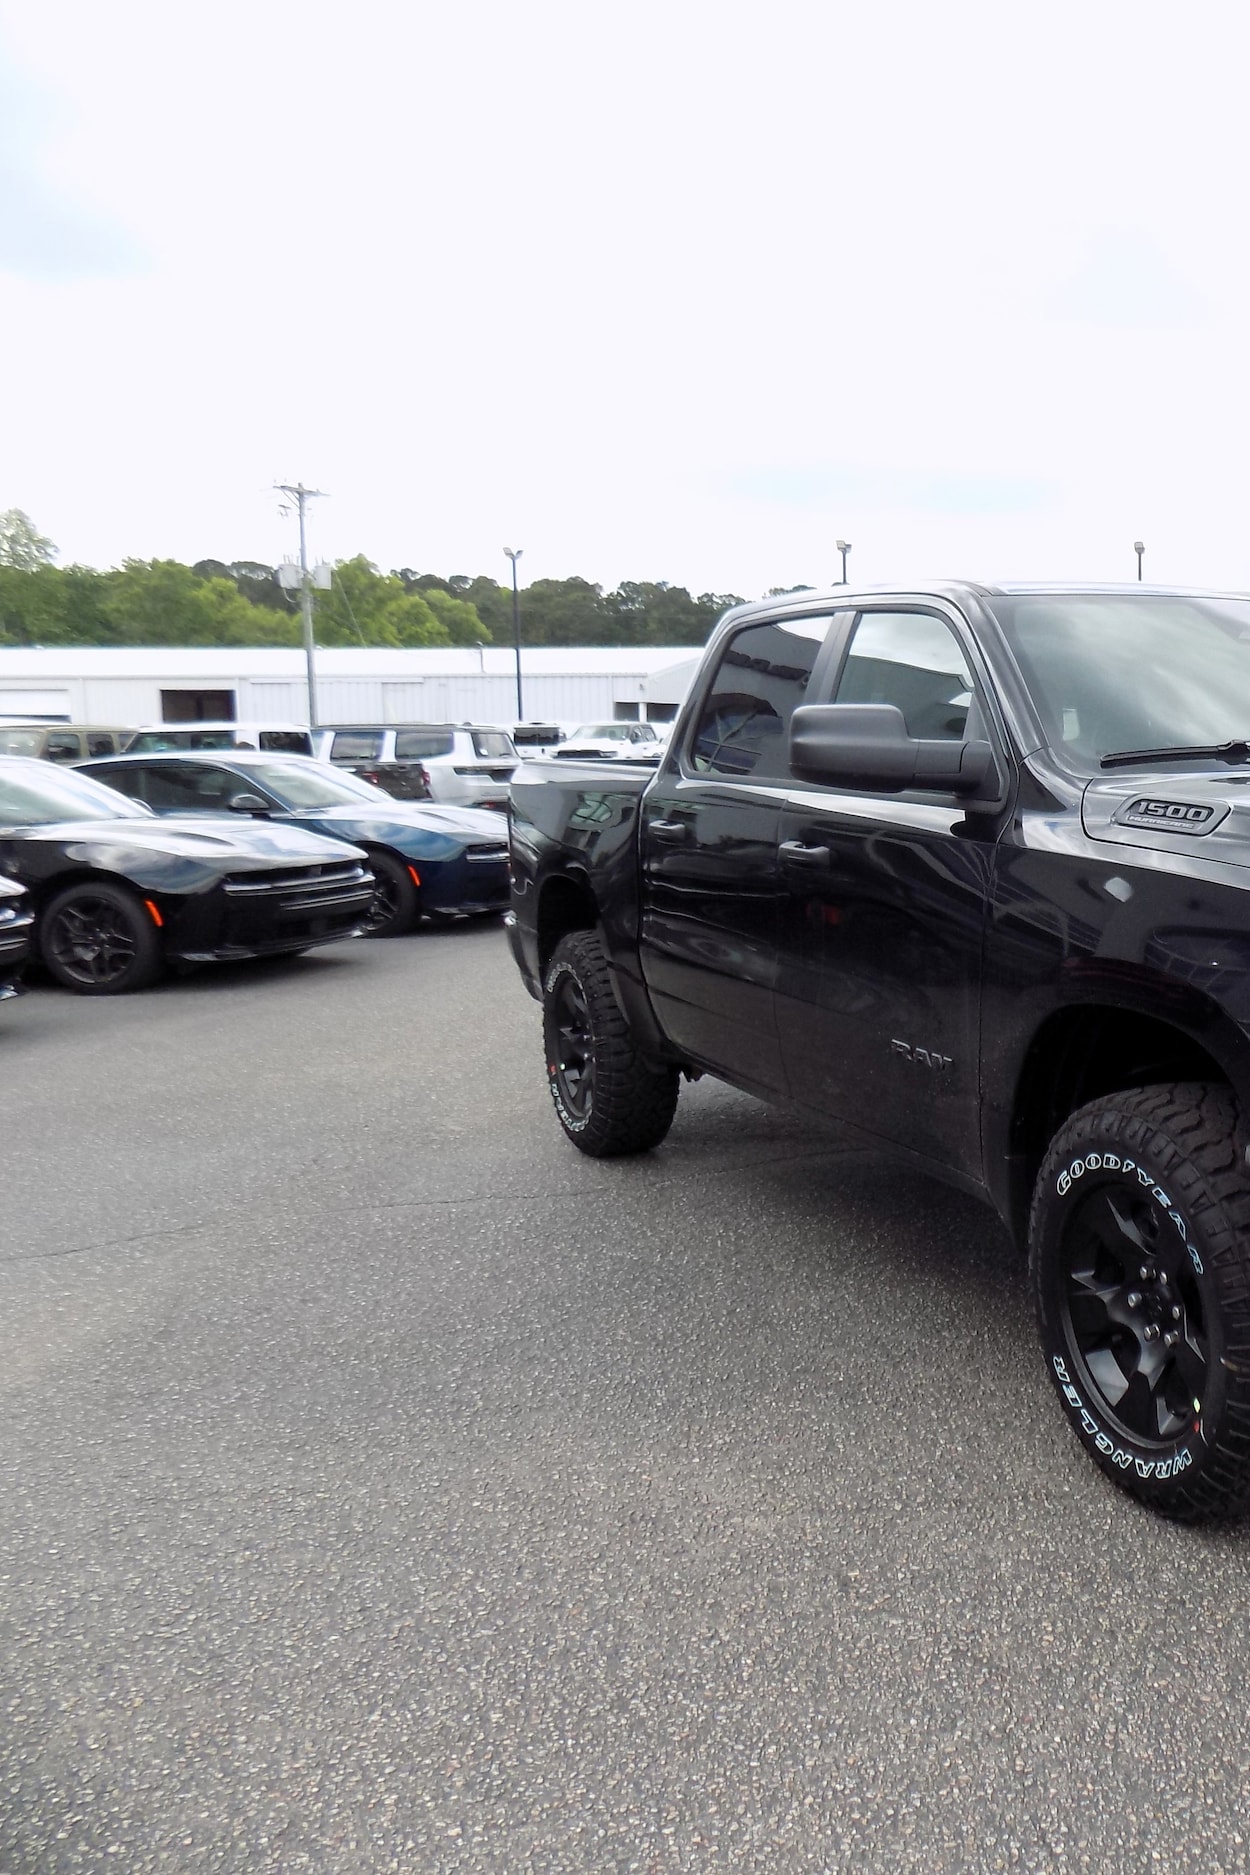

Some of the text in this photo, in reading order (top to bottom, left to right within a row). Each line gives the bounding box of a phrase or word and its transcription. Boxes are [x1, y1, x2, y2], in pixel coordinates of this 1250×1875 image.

[1138, 802, 1209, 821] 1500
[1055, 1152, 1204, 1276] GOODYEAR
[1052, 1355, 1193, 1480] WRANGLER
